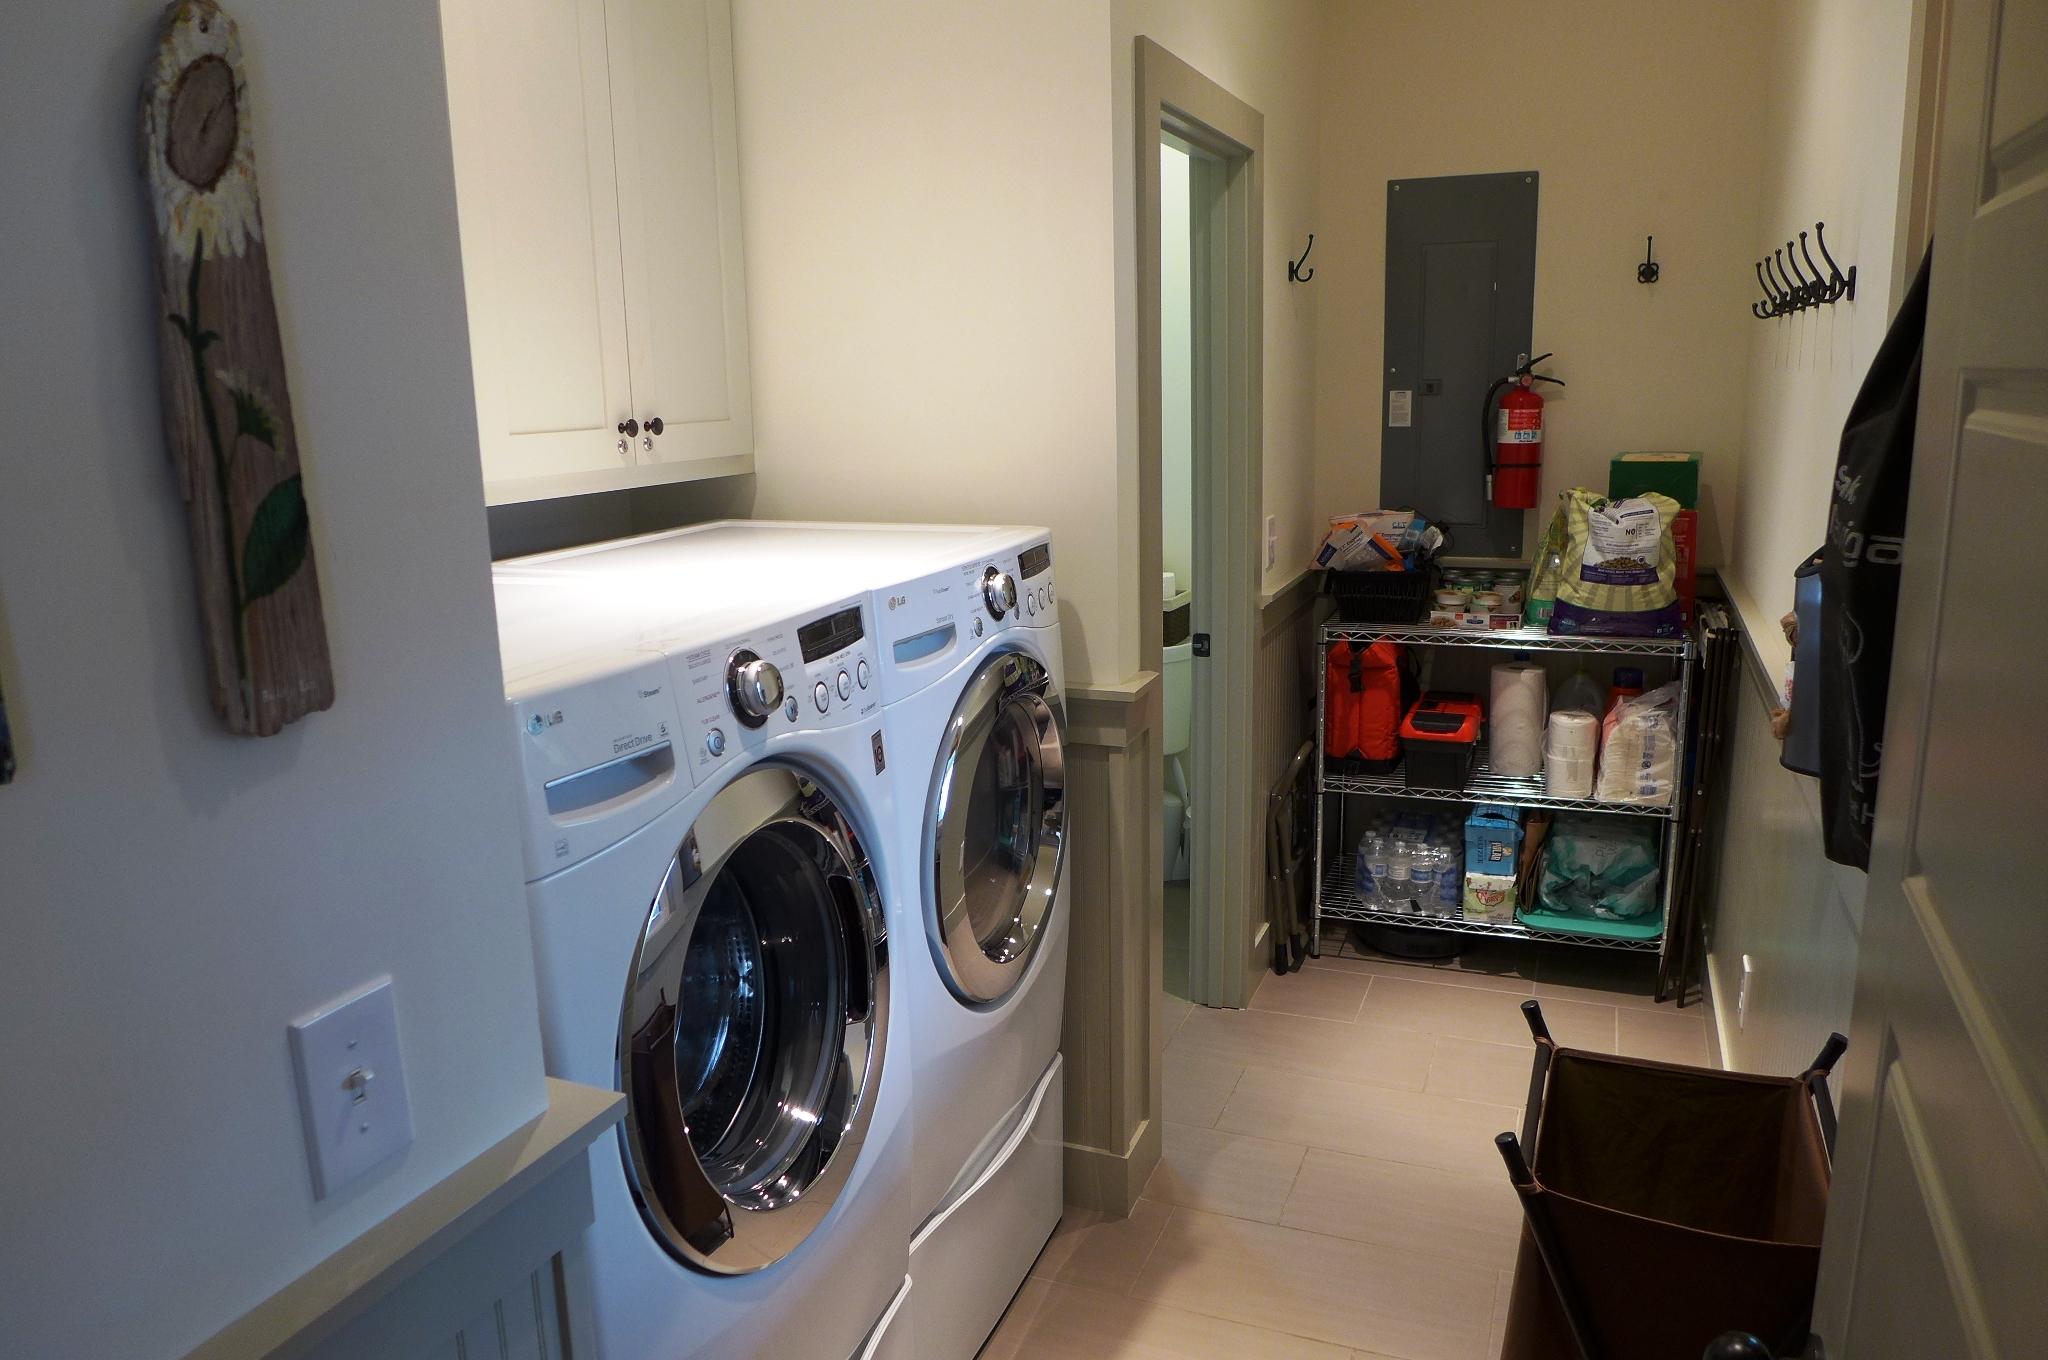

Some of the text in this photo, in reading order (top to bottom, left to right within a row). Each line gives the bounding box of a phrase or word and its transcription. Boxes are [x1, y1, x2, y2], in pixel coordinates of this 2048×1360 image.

[1625, 528, 1636, 536] NO
[897, 595, 906, 606] LG
[613, 739, 635, 753] Direct
[634, 734, 653, 747] Drive
